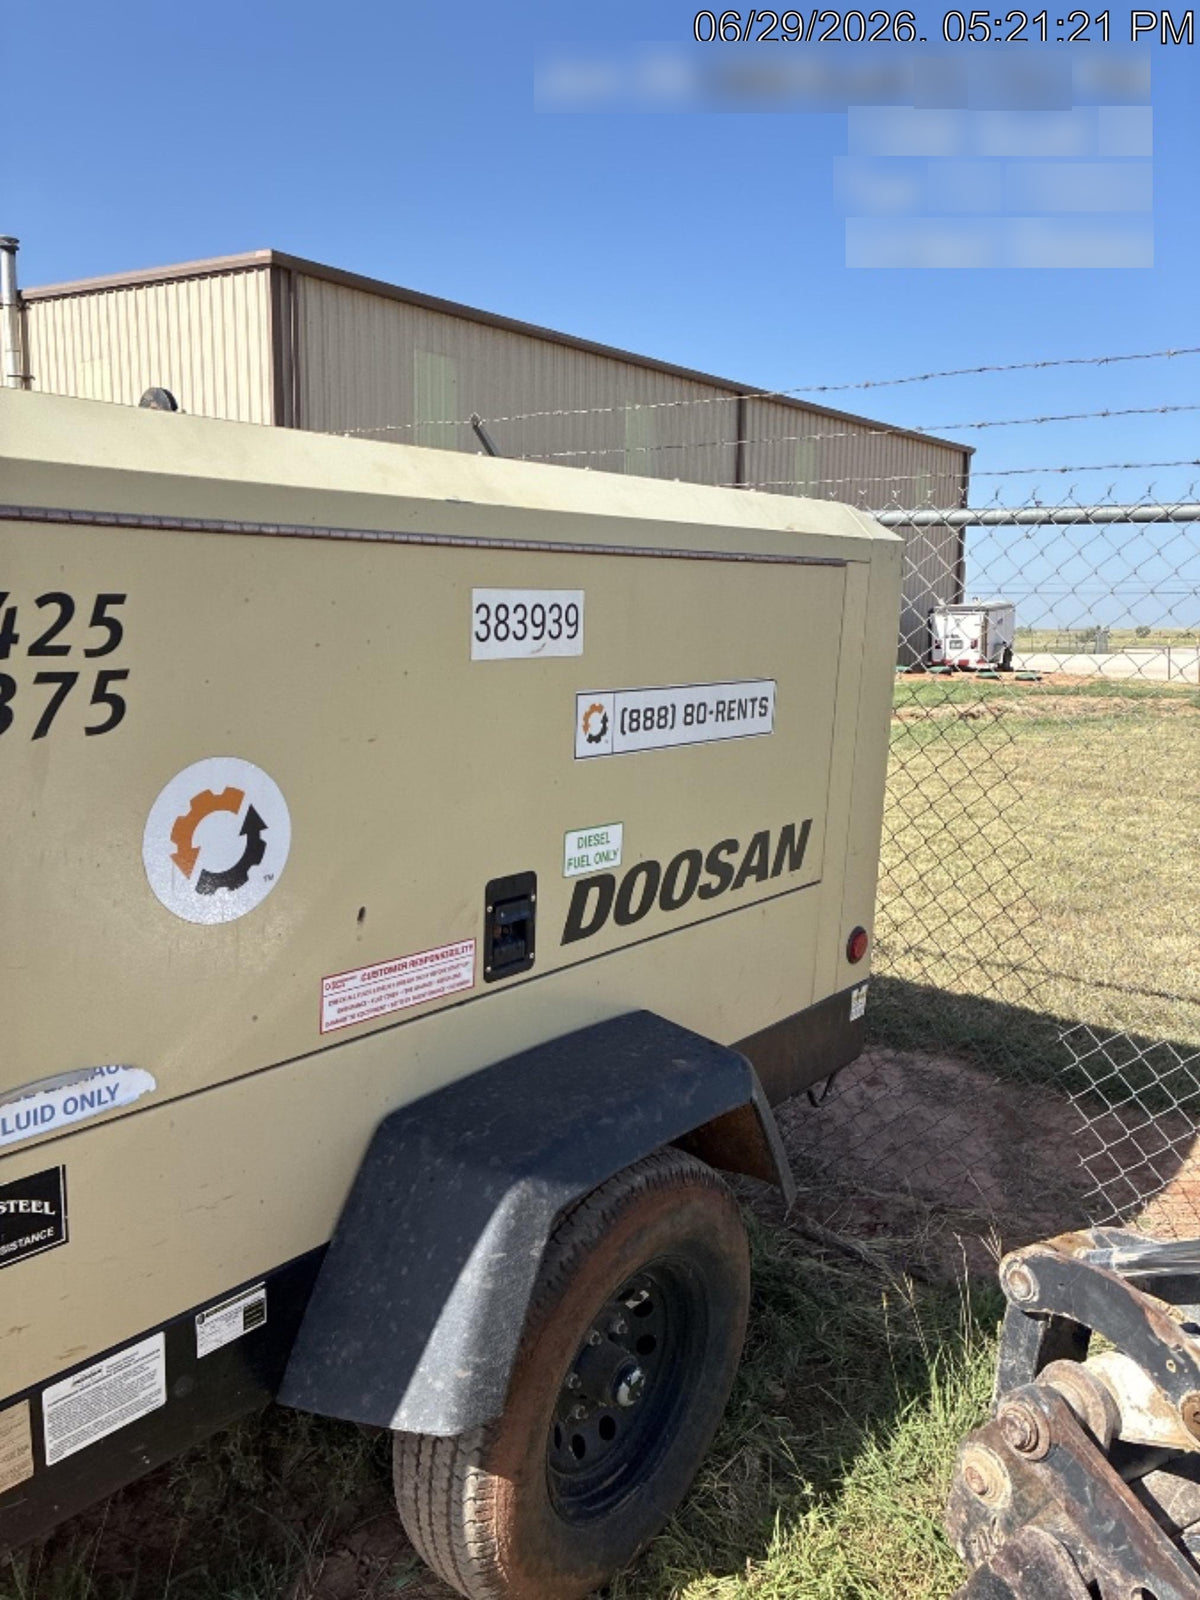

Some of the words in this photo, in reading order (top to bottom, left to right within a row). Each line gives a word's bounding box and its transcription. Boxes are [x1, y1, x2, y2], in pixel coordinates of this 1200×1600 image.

[474, 602, 579, 642] 383939
[620, 703, 677, 735] (888)
[683, 696, 769, 726] 80-RENTS
[577, 832, 611, 849] DIESEL
[567, 855, 590, 871] FUEL
[594, 848, 619, 865] ONLY
[560, 818, 813, 946] DOOSAN
[361, 961, 408, 982] CUSTOMER
[63, 1083, 120, 1116] ONLY
